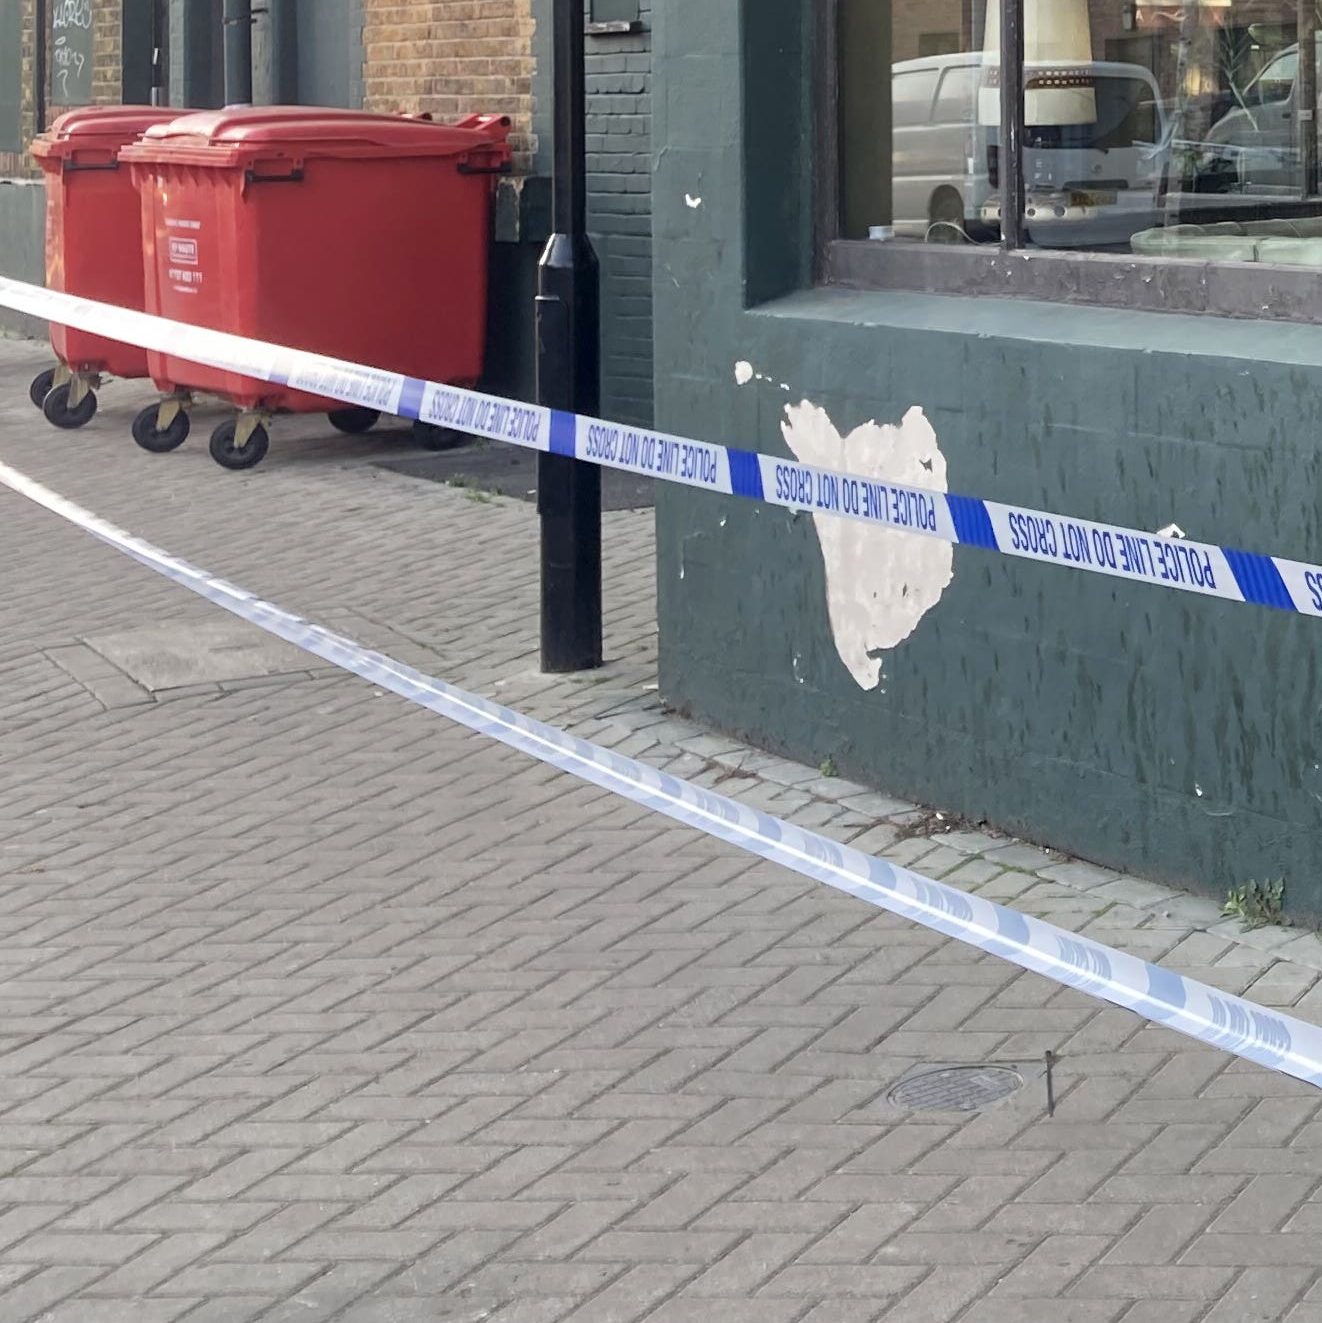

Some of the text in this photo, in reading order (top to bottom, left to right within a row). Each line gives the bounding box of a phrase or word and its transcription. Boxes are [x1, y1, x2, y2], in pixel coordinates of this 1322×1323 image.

[427, 389, 538, 441] POLICE LINE DO NOT CROSS
[586, 423, 718, 485] POLICE LINE DO NOT CROSS
[775, 463, 937, 532] POLICE LINE DO NOT CROSS
[1007, 511, 1217, 589] POLICE LINE DO NOT CROSS
